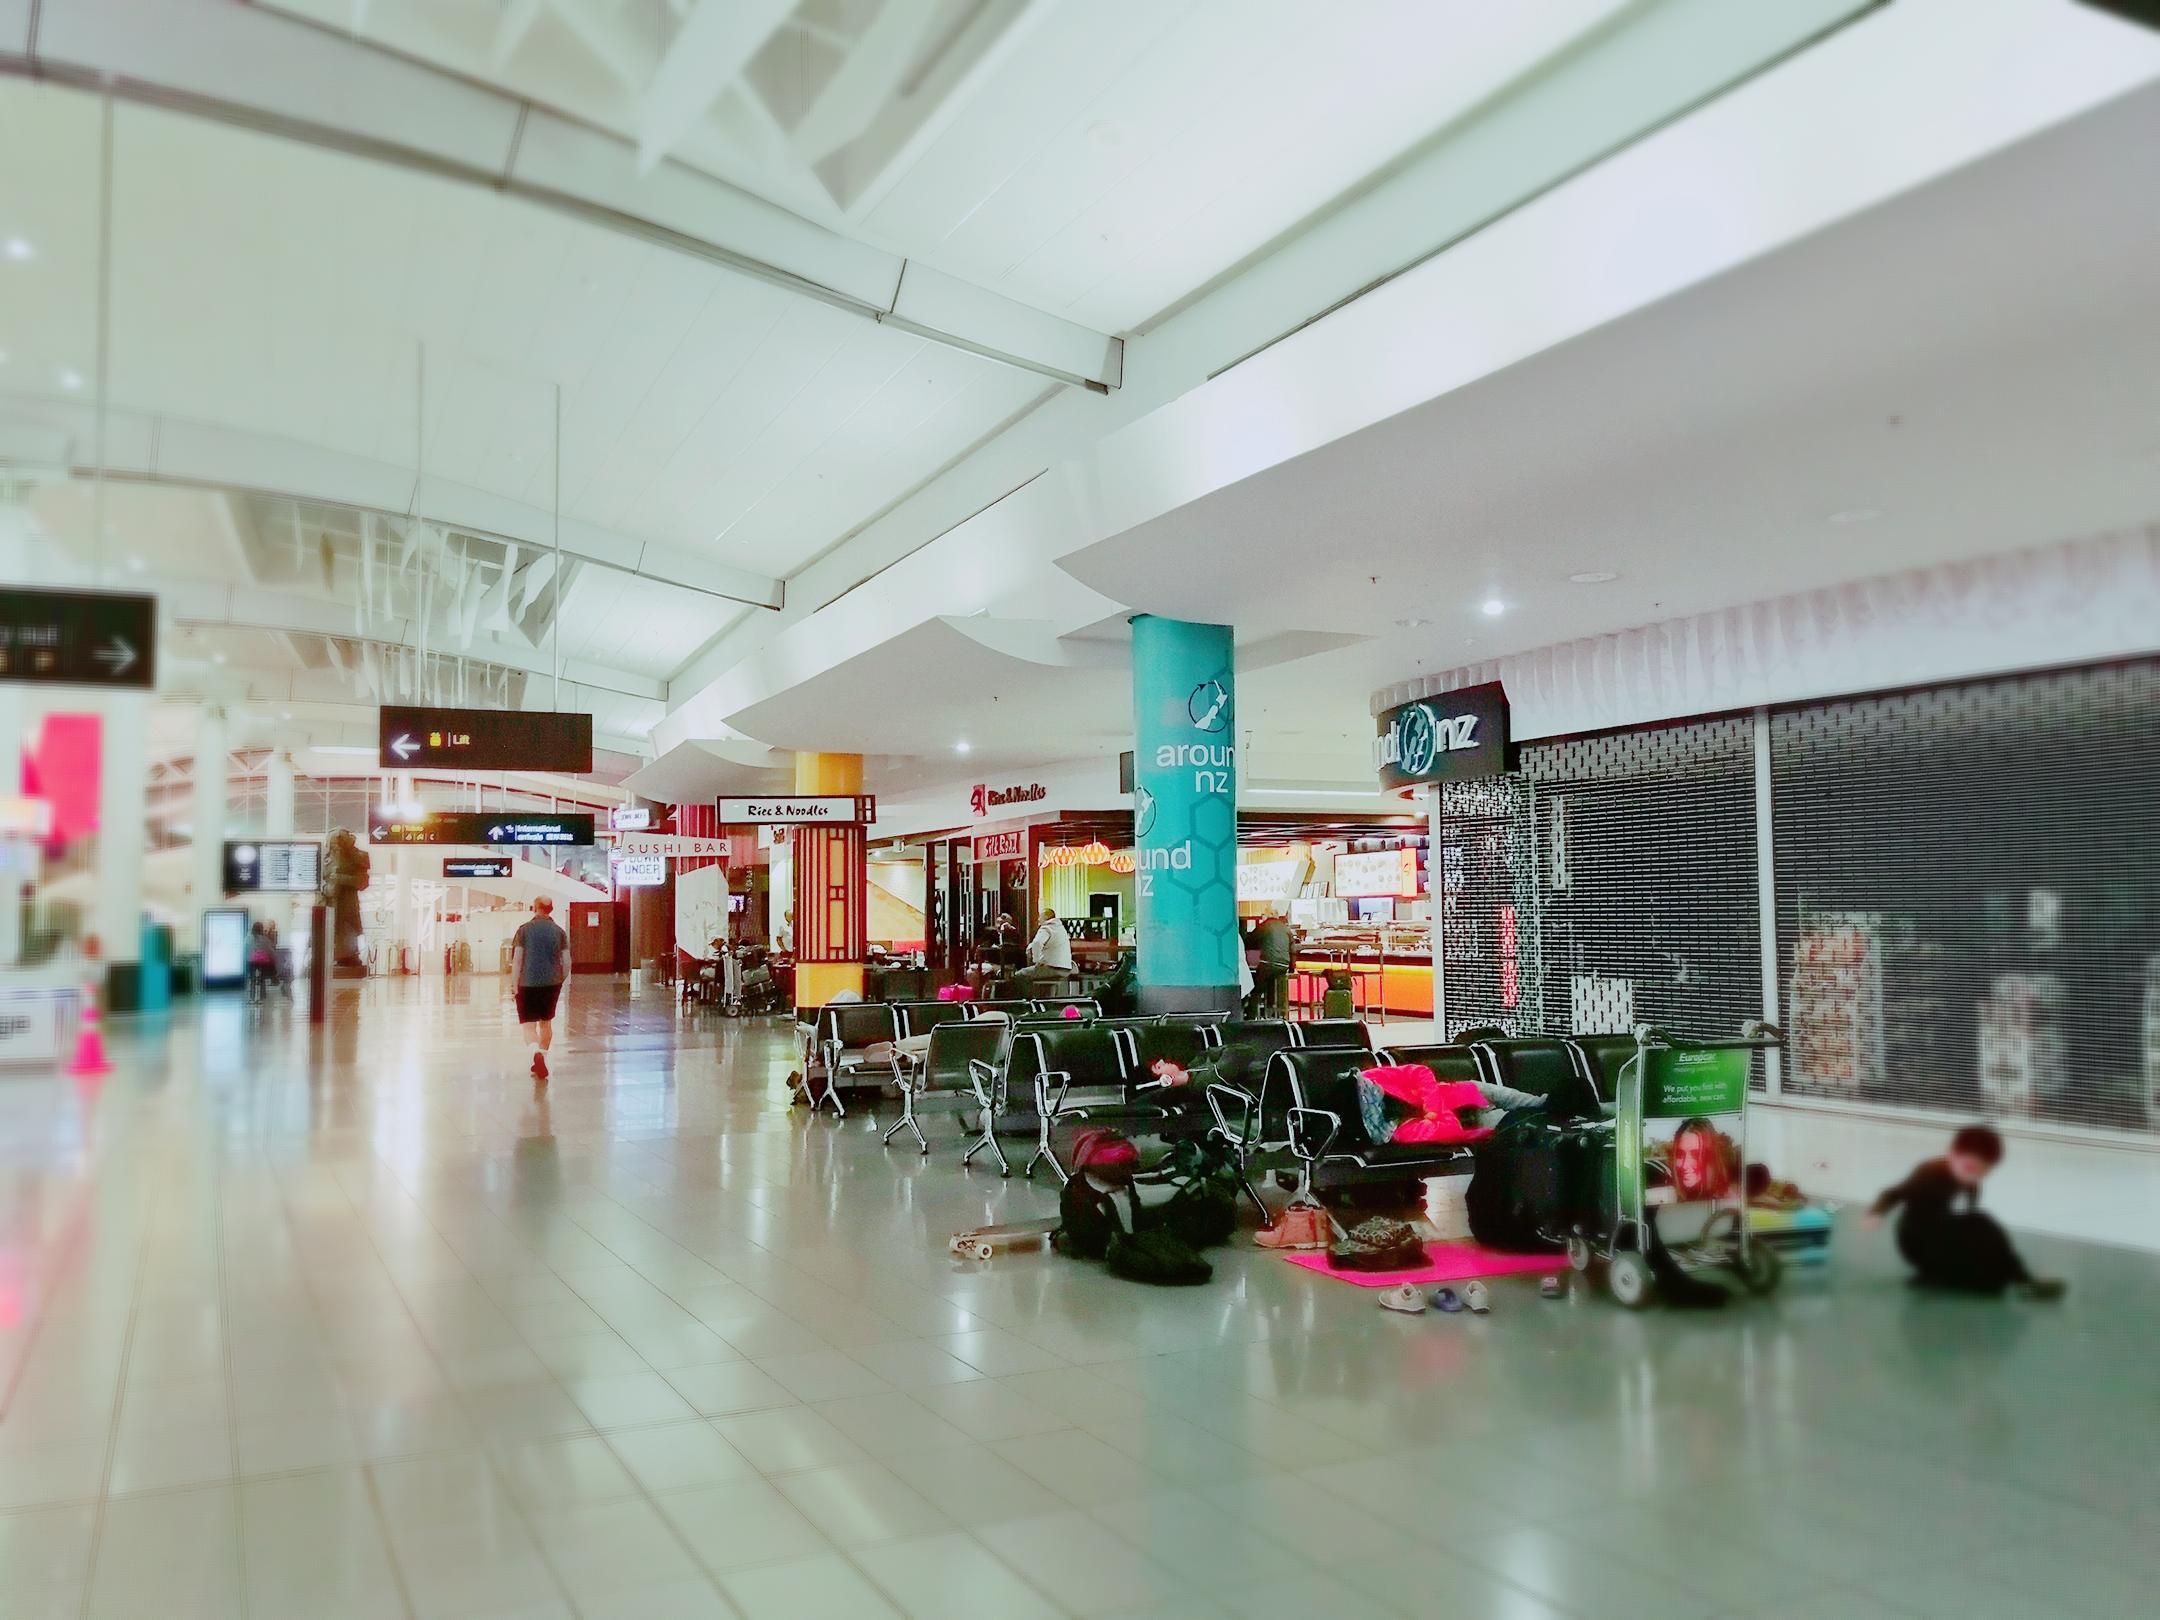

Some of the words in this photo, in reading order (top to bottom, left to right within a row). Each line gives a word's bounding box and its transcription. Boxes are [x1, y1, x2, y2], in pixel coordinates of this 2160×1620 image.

[1436, 714, 1481, 753] nz
[1195, 770, 1229, 793] nz
[748, 805, 772, 816] Rice
[775, 805, 784, 816] &
[786, 804, 829, 816] Noodles
[628, 842, 681, 854] SUSHI
[694, 842, 727, 853] BAR
[624, 864, 660, 874] UNDER
[1663, 1085, 1676, 1093] We
[1677, 1085, 1689, 1094] put
